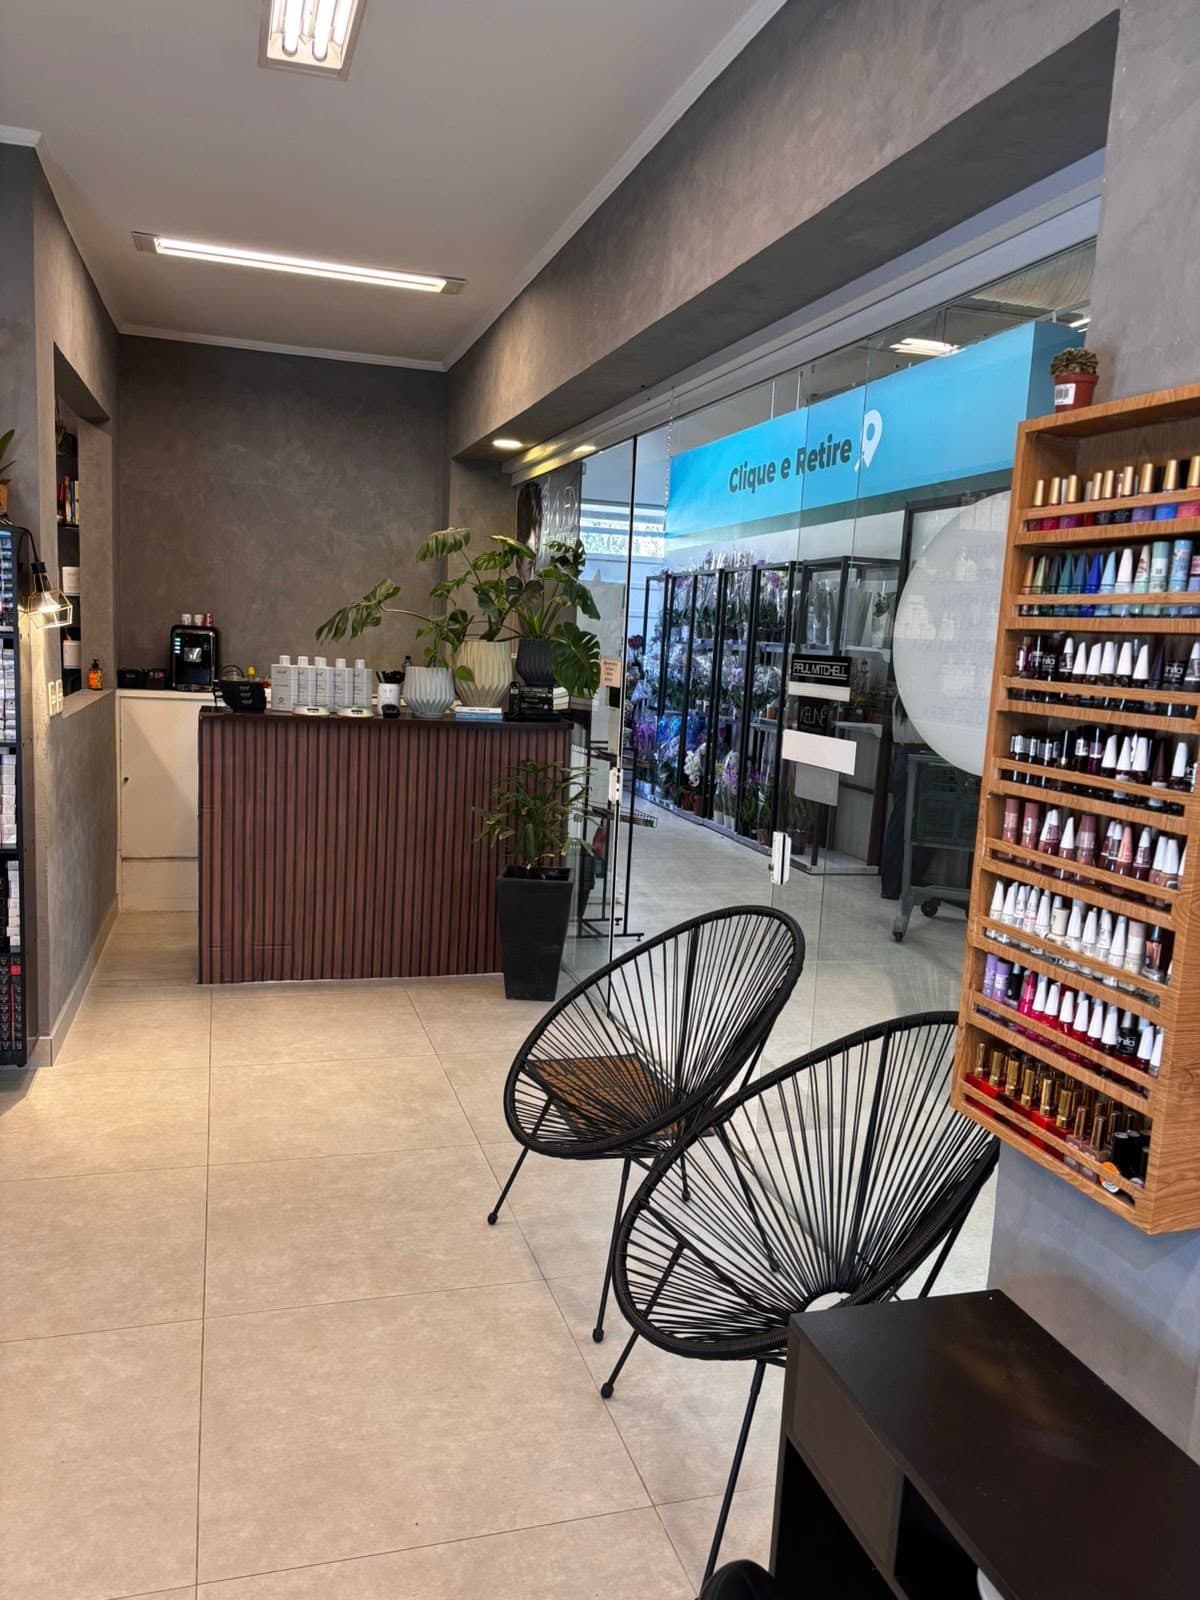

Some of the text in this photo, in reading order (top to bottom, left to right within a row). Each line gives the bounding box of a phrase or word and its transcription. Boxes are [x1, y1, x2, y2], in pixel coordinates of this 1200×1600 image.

[729, 433, 852, 494] Clique e Retire
